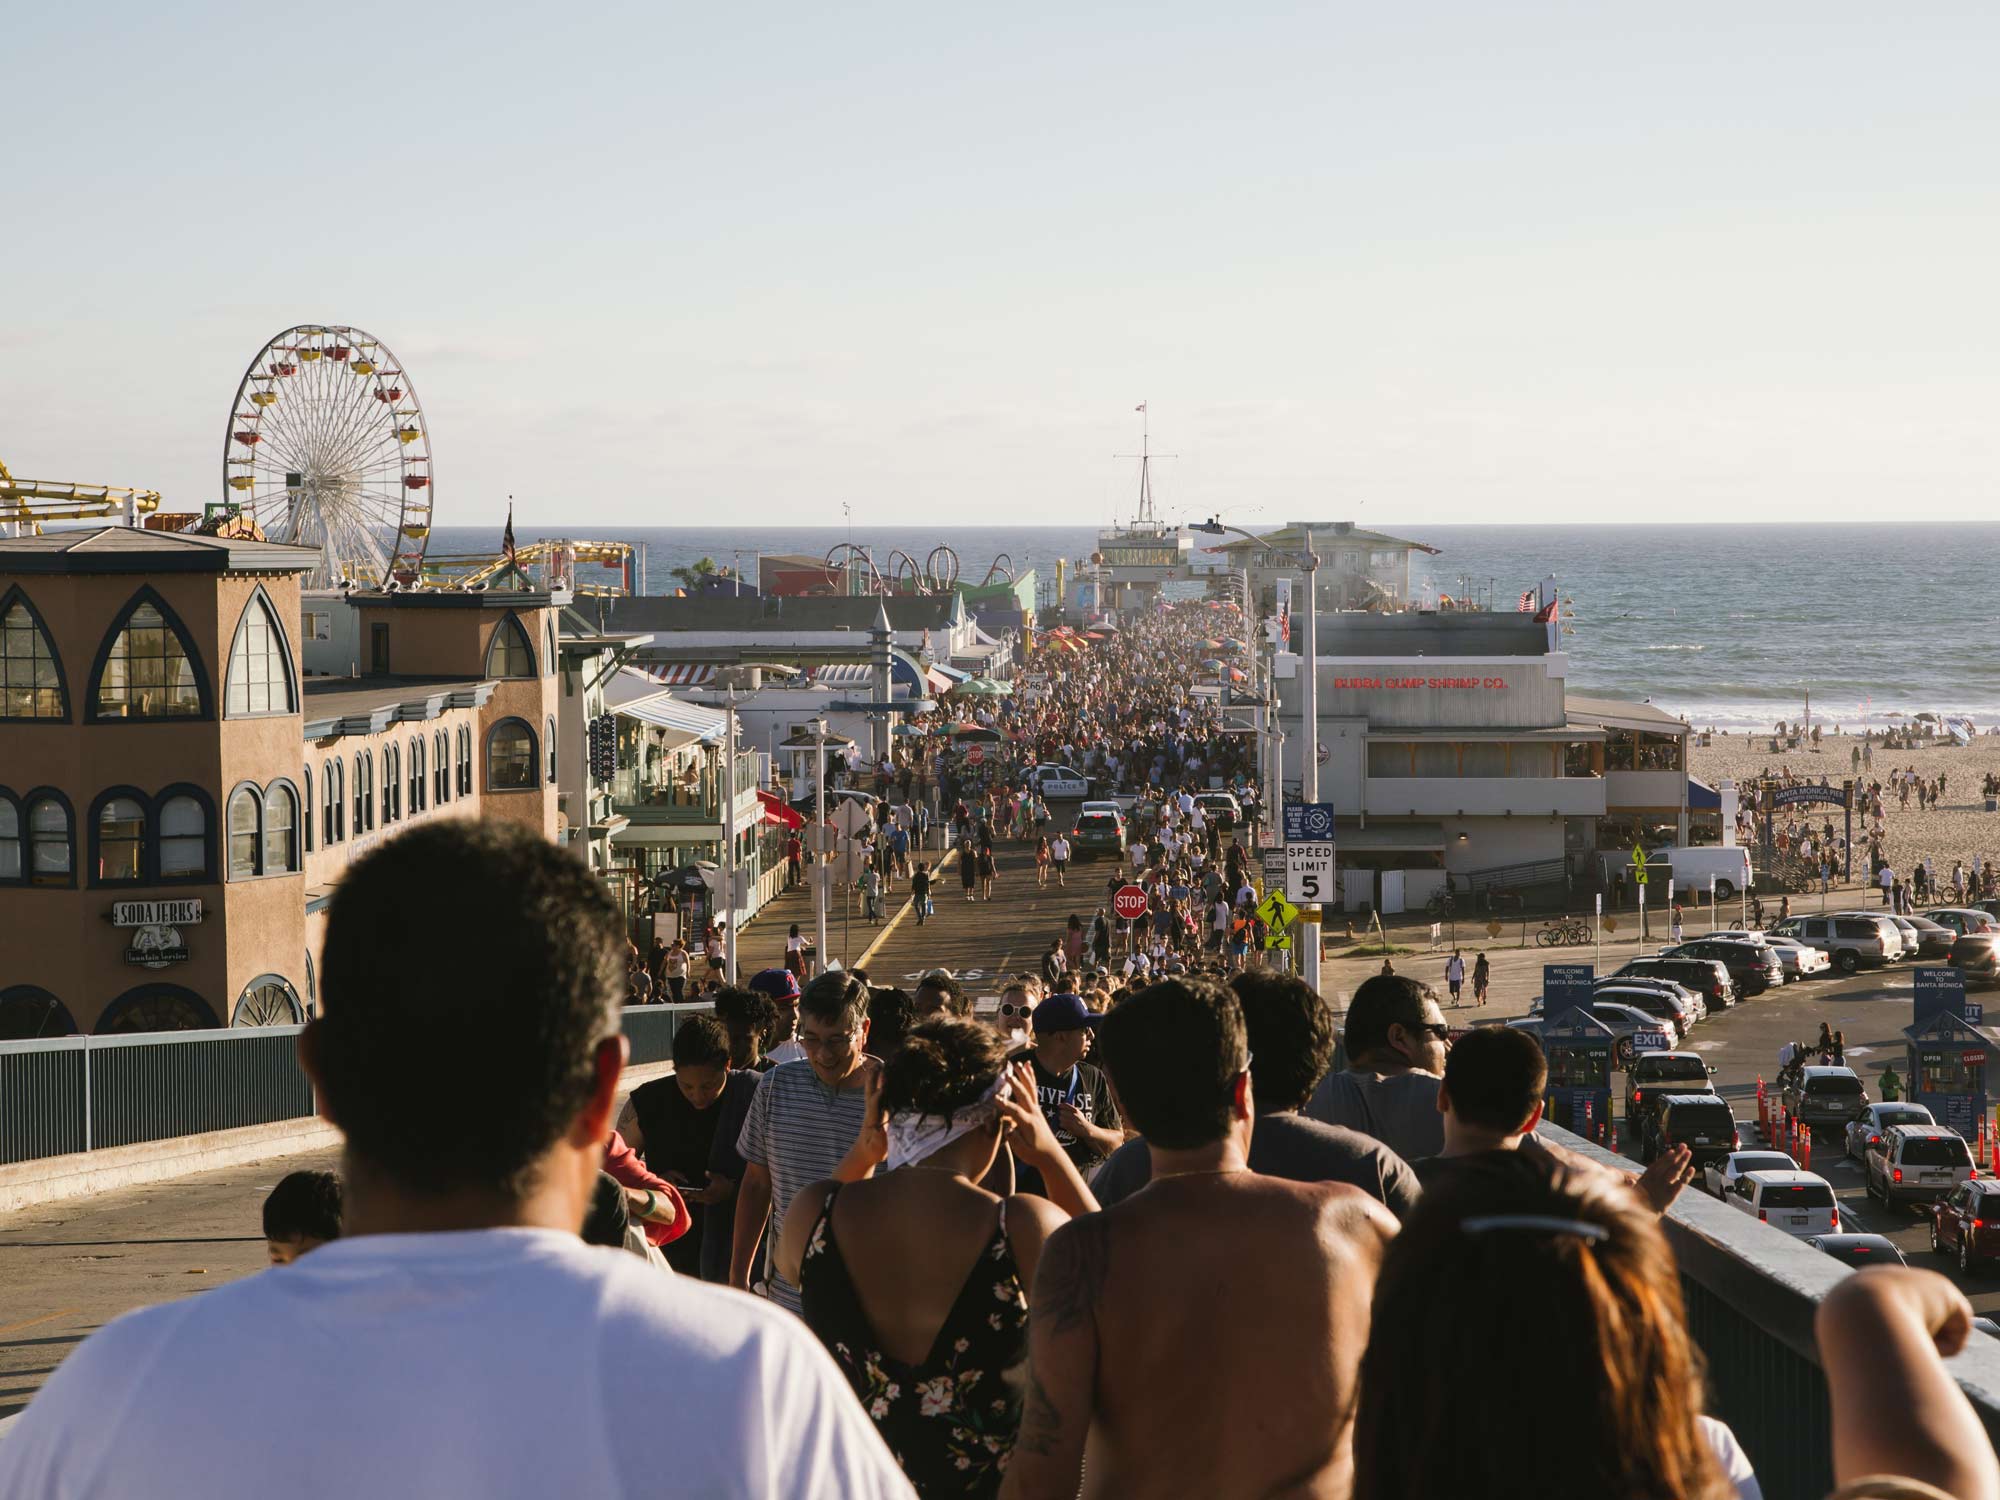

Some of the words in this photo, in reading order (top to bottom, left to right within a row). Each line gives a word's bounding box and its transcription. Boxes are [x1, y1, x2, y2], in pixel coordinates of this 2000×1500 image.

[1334, 678, 1382, 689] BUBBA
[1384, 678, 1425, 689] GUMP
[1427, 678, 1480, 689] SHRIMP
[602, 719, 610, 734] AL
[602, 740, 611, 777] MARE
[968, 751, 983, 759] STOP
[1775, 789, 1798, 800] SANTA
[1799, 787, 1828, 796] MONICA
[1829, 790, 1844, 799] PIER
[1289, 848, 1332, 857] SPEED
[1293, 862, 1327, 871] LIMIT
[1302, 875, 1320, 898] 5
[1116, 895, 1146, 908] STOP
[120, 904, 153, 924] SODA
[156, 902, 193, 922] JERKS
[1634, 1034, 1664, 1046] EXIT
